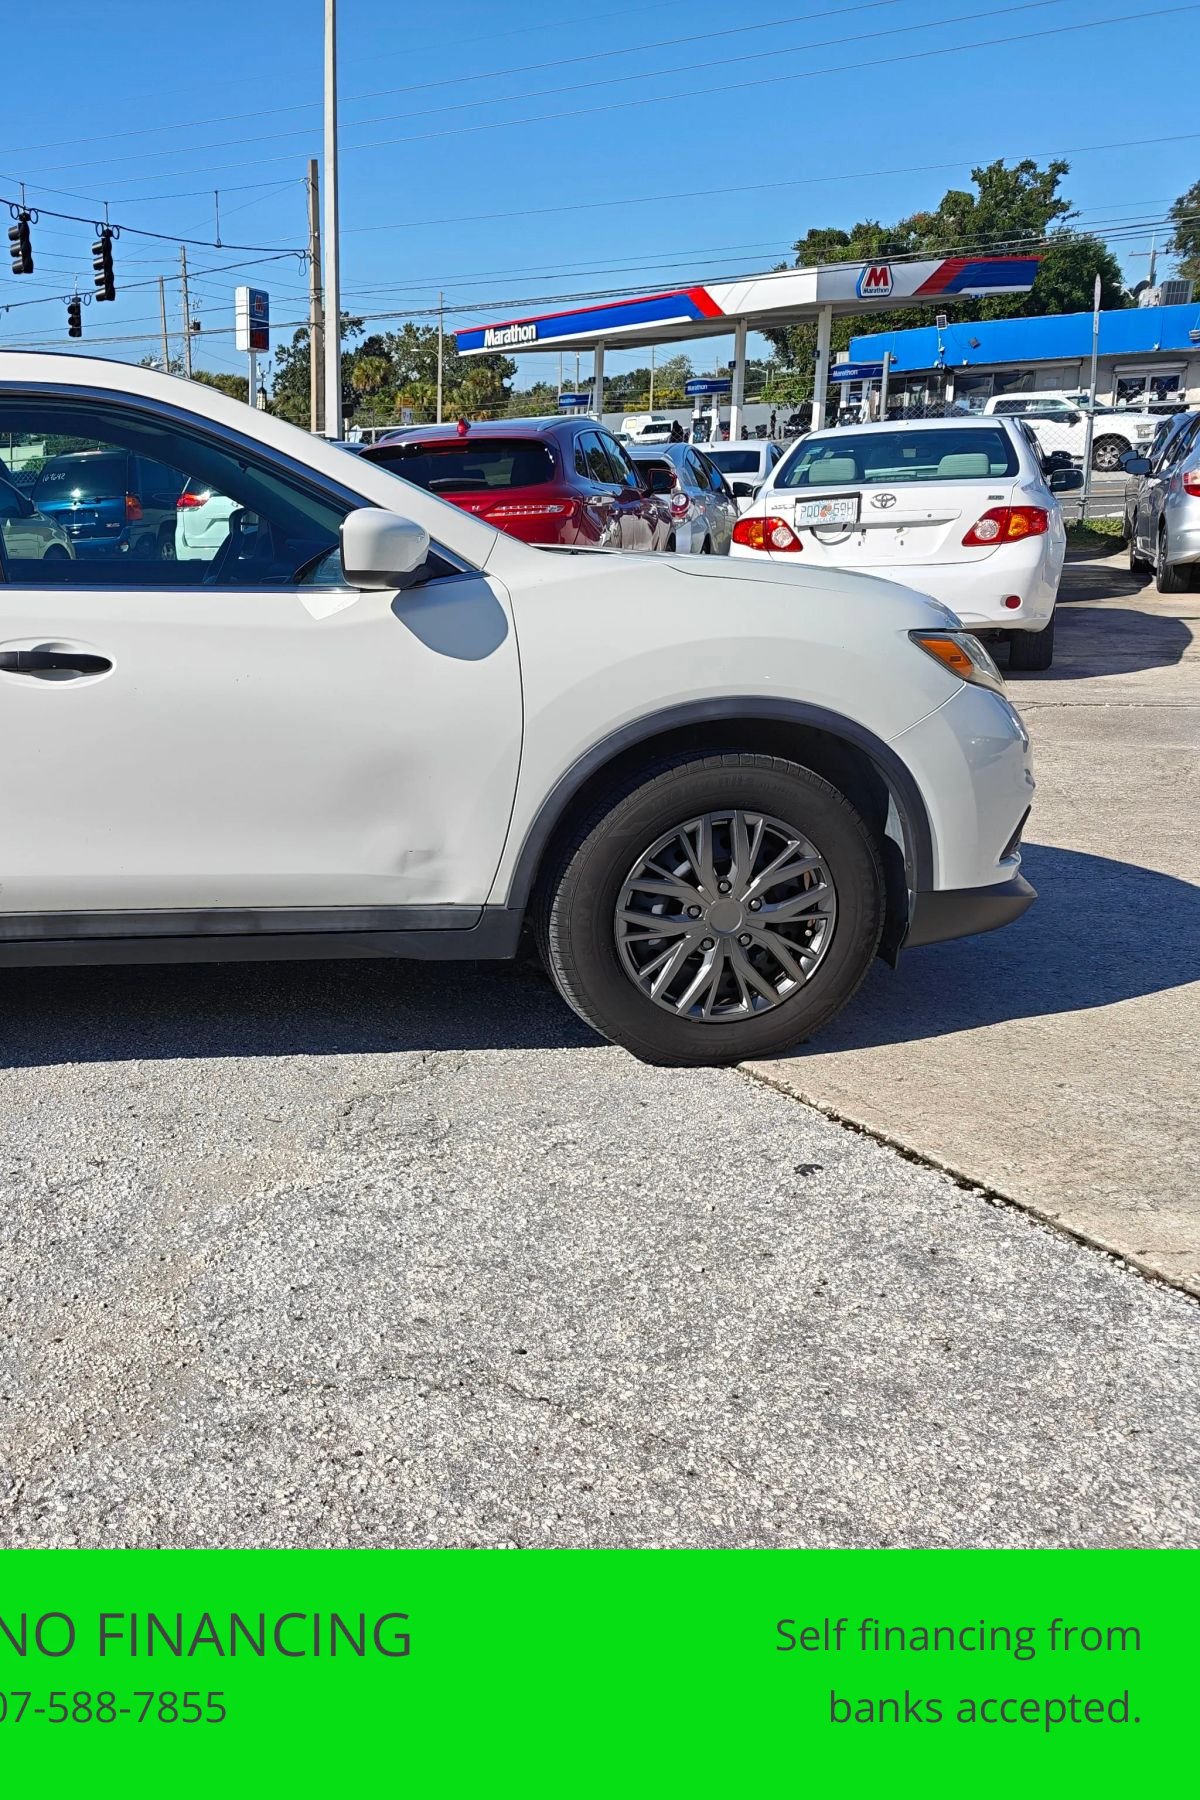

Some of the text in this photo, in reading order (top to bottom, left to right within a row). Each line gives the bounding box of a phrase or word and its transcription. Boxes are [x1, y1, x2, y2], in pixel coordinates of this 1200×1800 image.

[865, 267, 889, 287] M
[483, 323, 537, 347] Marathon
[832, 368, 858, 377] Marathon
